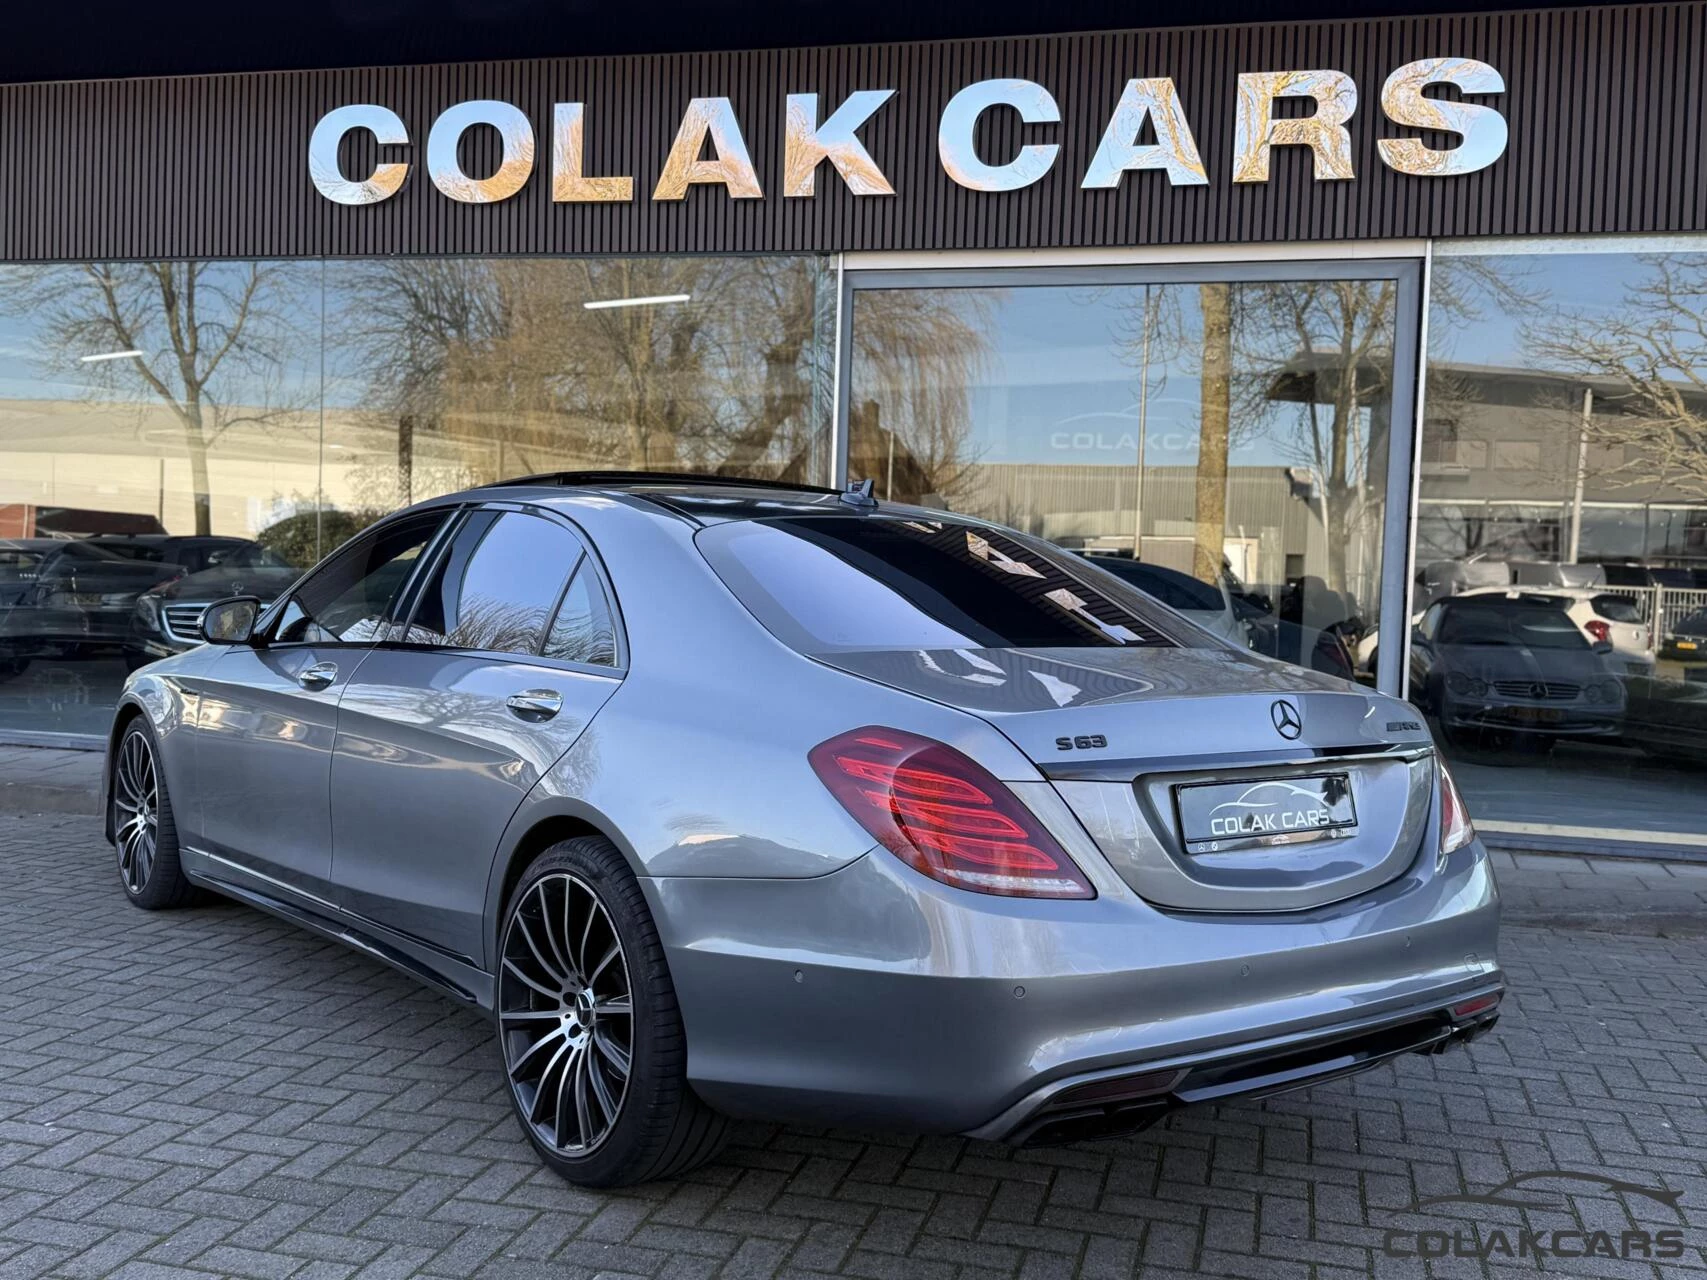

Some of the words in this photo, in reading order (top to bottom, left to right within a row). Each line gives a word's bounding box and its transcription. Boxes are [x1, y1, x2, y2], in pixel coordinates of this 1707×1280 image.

[308, 88, 898, 206] COLAK
[938, 56, 1510, 193] CARS
[1050, 432, 1255, 450] COLAKCAS
[1211, 813, 1277, 836] COLAK
[1281, 808, 1330, 829] CARS
